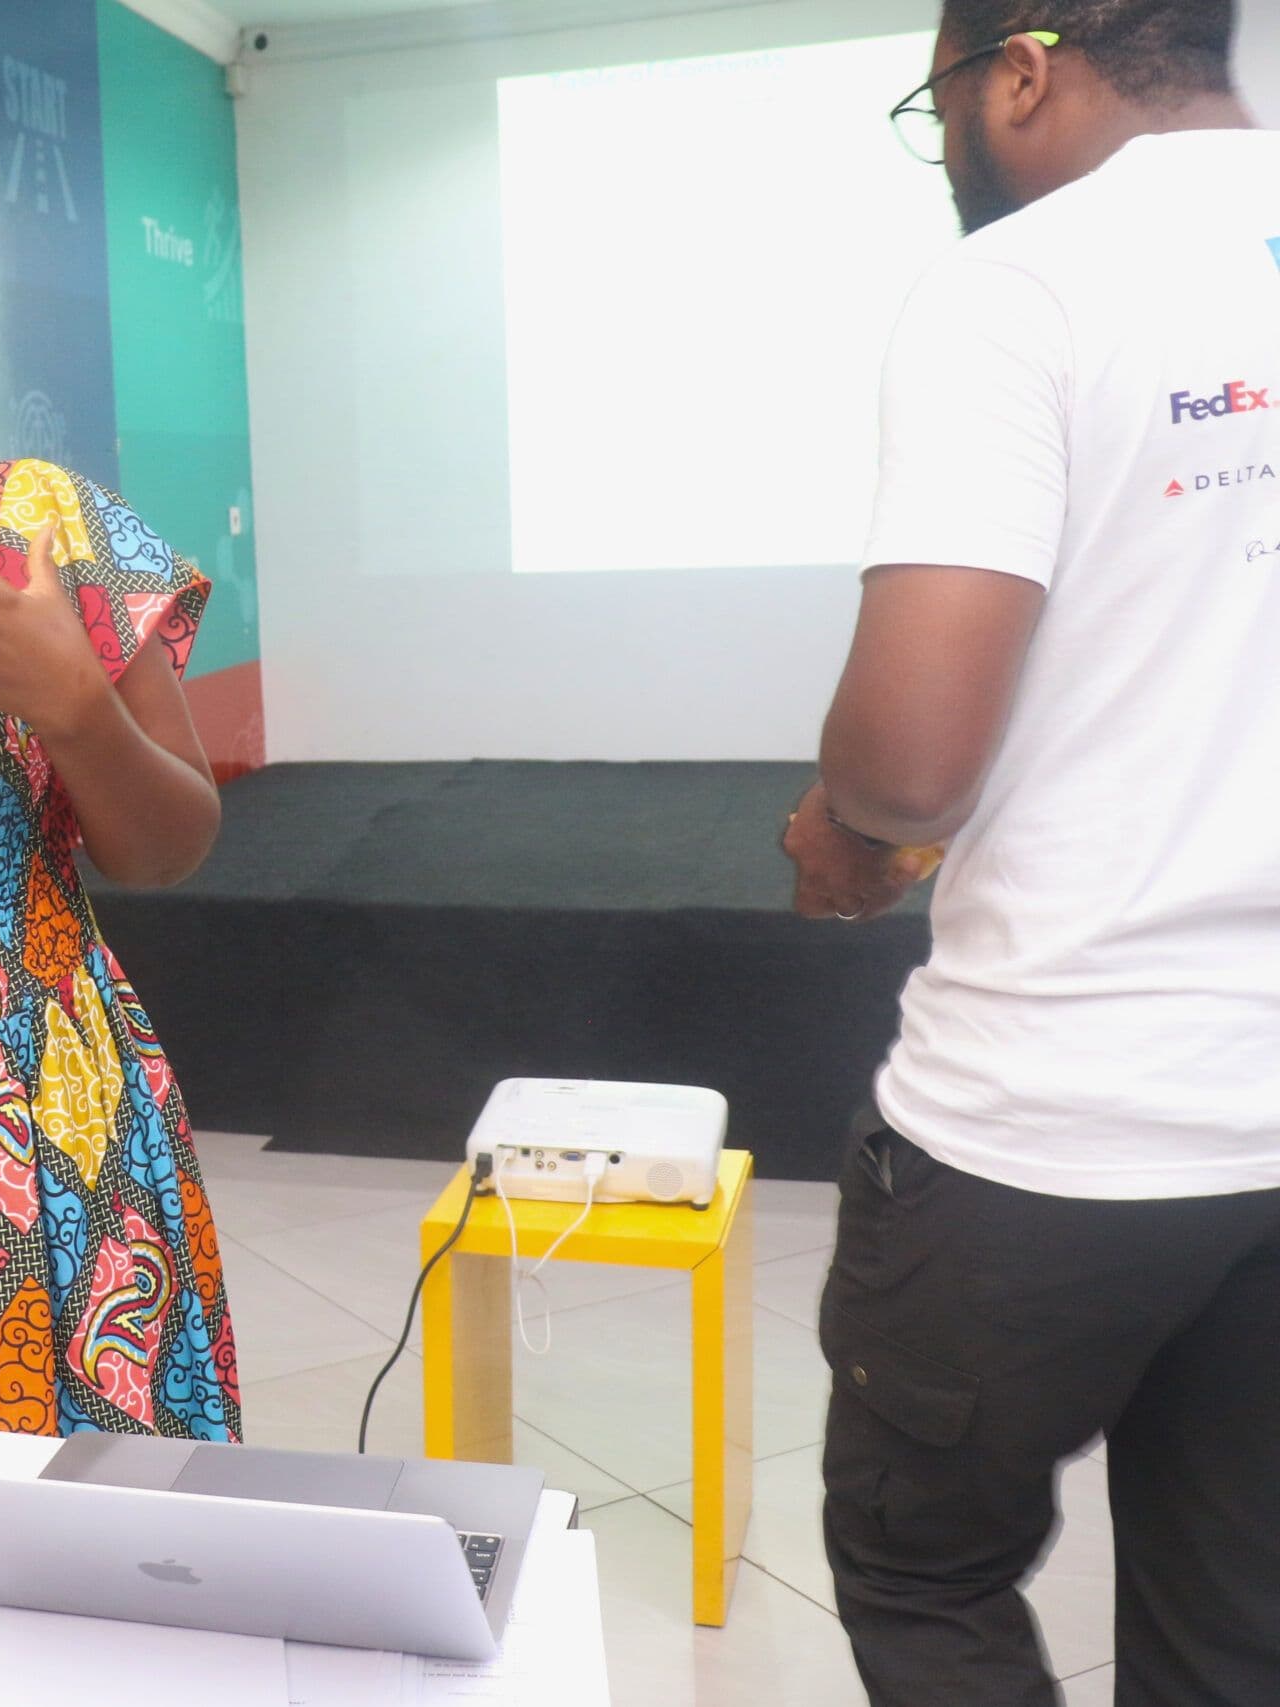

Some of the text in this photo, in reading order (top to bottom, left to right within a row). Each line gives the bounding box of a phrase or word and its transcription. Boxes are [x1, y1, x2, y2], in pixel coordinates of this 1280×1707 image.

[3, 54, 68, 140] START
[141, 216, 194, 268] Thrive
[1169, 380, 1270, 425] FedEx
[1195, 464, 1276, 490] DELTA
